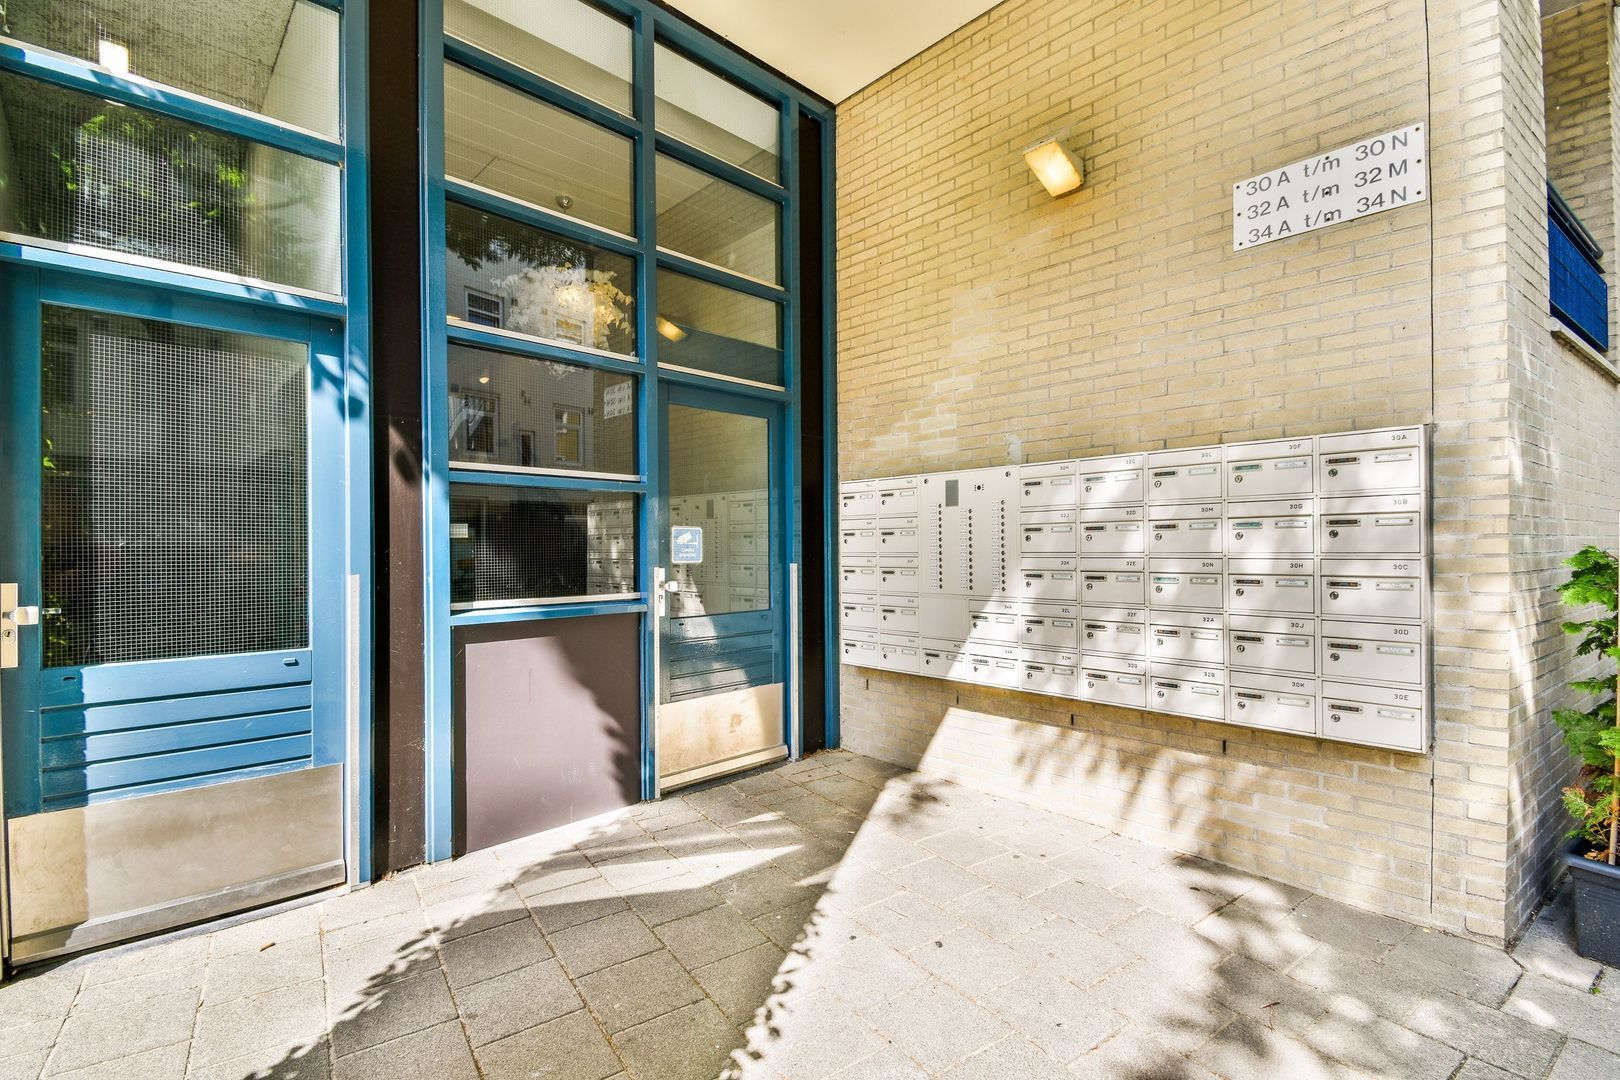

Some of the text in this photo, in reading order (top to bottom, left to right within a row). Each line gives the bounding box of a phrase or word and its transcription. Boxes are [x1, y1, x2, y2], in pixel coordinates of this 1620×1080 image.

[1303, 157, 1340, 178] t/m
[1302, 182, 1340, 203] t/m
[1304, 208, 1342, 228] t/m
